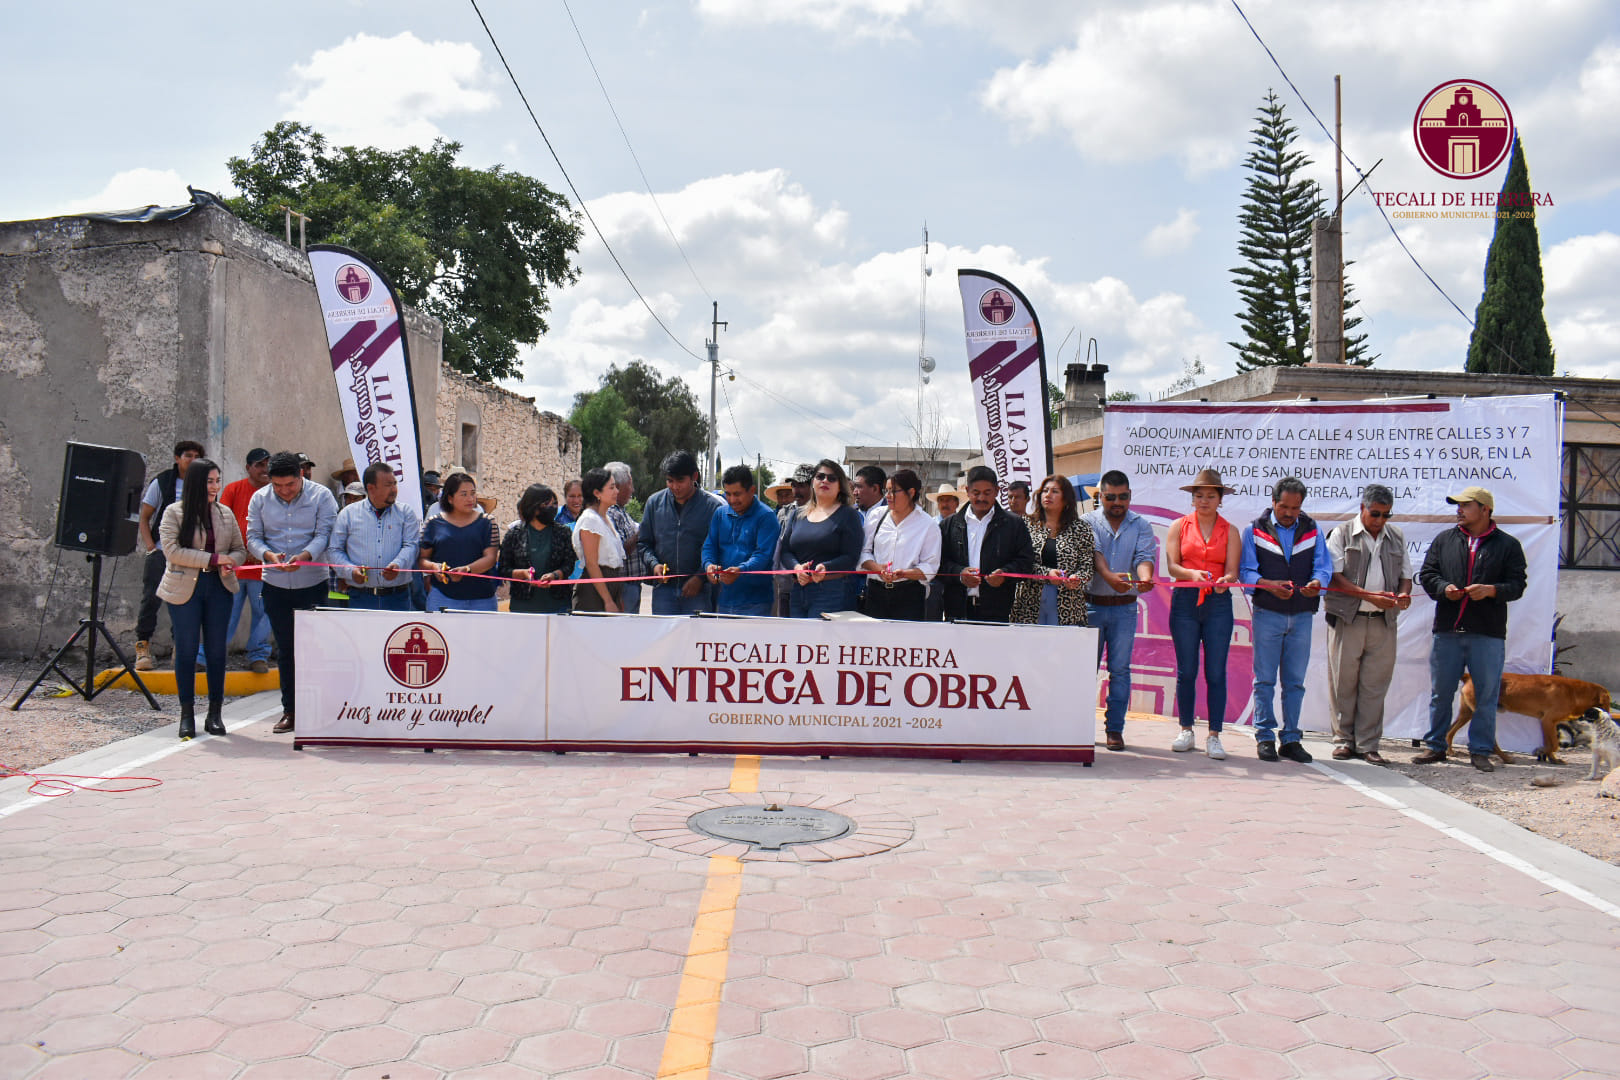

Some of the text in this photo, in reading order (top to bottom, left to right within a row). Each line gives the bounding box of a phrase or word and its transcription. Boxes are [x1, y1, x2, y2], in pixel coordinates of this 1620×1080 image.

[1257, 429, 1273, 441] DE
[1277, 428, 1295, 441] LA
[1298, 429, 1341, 441] CALLE
[1345, 429, 1353, 440] 4
[1357, 429, 1385, 441] SUR
[1389, 428, 1433, 441] ENTRE
[1437, 426, 1491, 440] CALLES
[1496, 427, 1504, 439] 3
[1507, 426, 1517, 439] Y
[1521, 426, 1530, 439] 7
[1123, 444, 1531, 460] ORIENTE; Y CALLE 7 ORIENTE ENTRE CALLES 4 Y 6 SUR, EN LA
[1135, 463, 1174, 475] JUNTA
[1241, 466, 1258, 477] DE
[1262, 466, 1290, 478] SAN
[1294, 467, 1409, 479] BUENAVENTURA
[1412, 467, 1518, 480] TETLANANCA,
[1224, 483, 1260, 496] CALI
[1306, 486, 1352, 499] RRERA,
[696, 642, 959, 669] TECALI DE HERRERA
[620, 666, 1031, 711] ENTREGA DE OBRA
[386, 692, 442, 705] TECALI
[337, 701, 494, 730] ¡nos une y cumple!
[708, 712, 943, 729] GOBIERNO MUNICIPAL 2021 -2024
